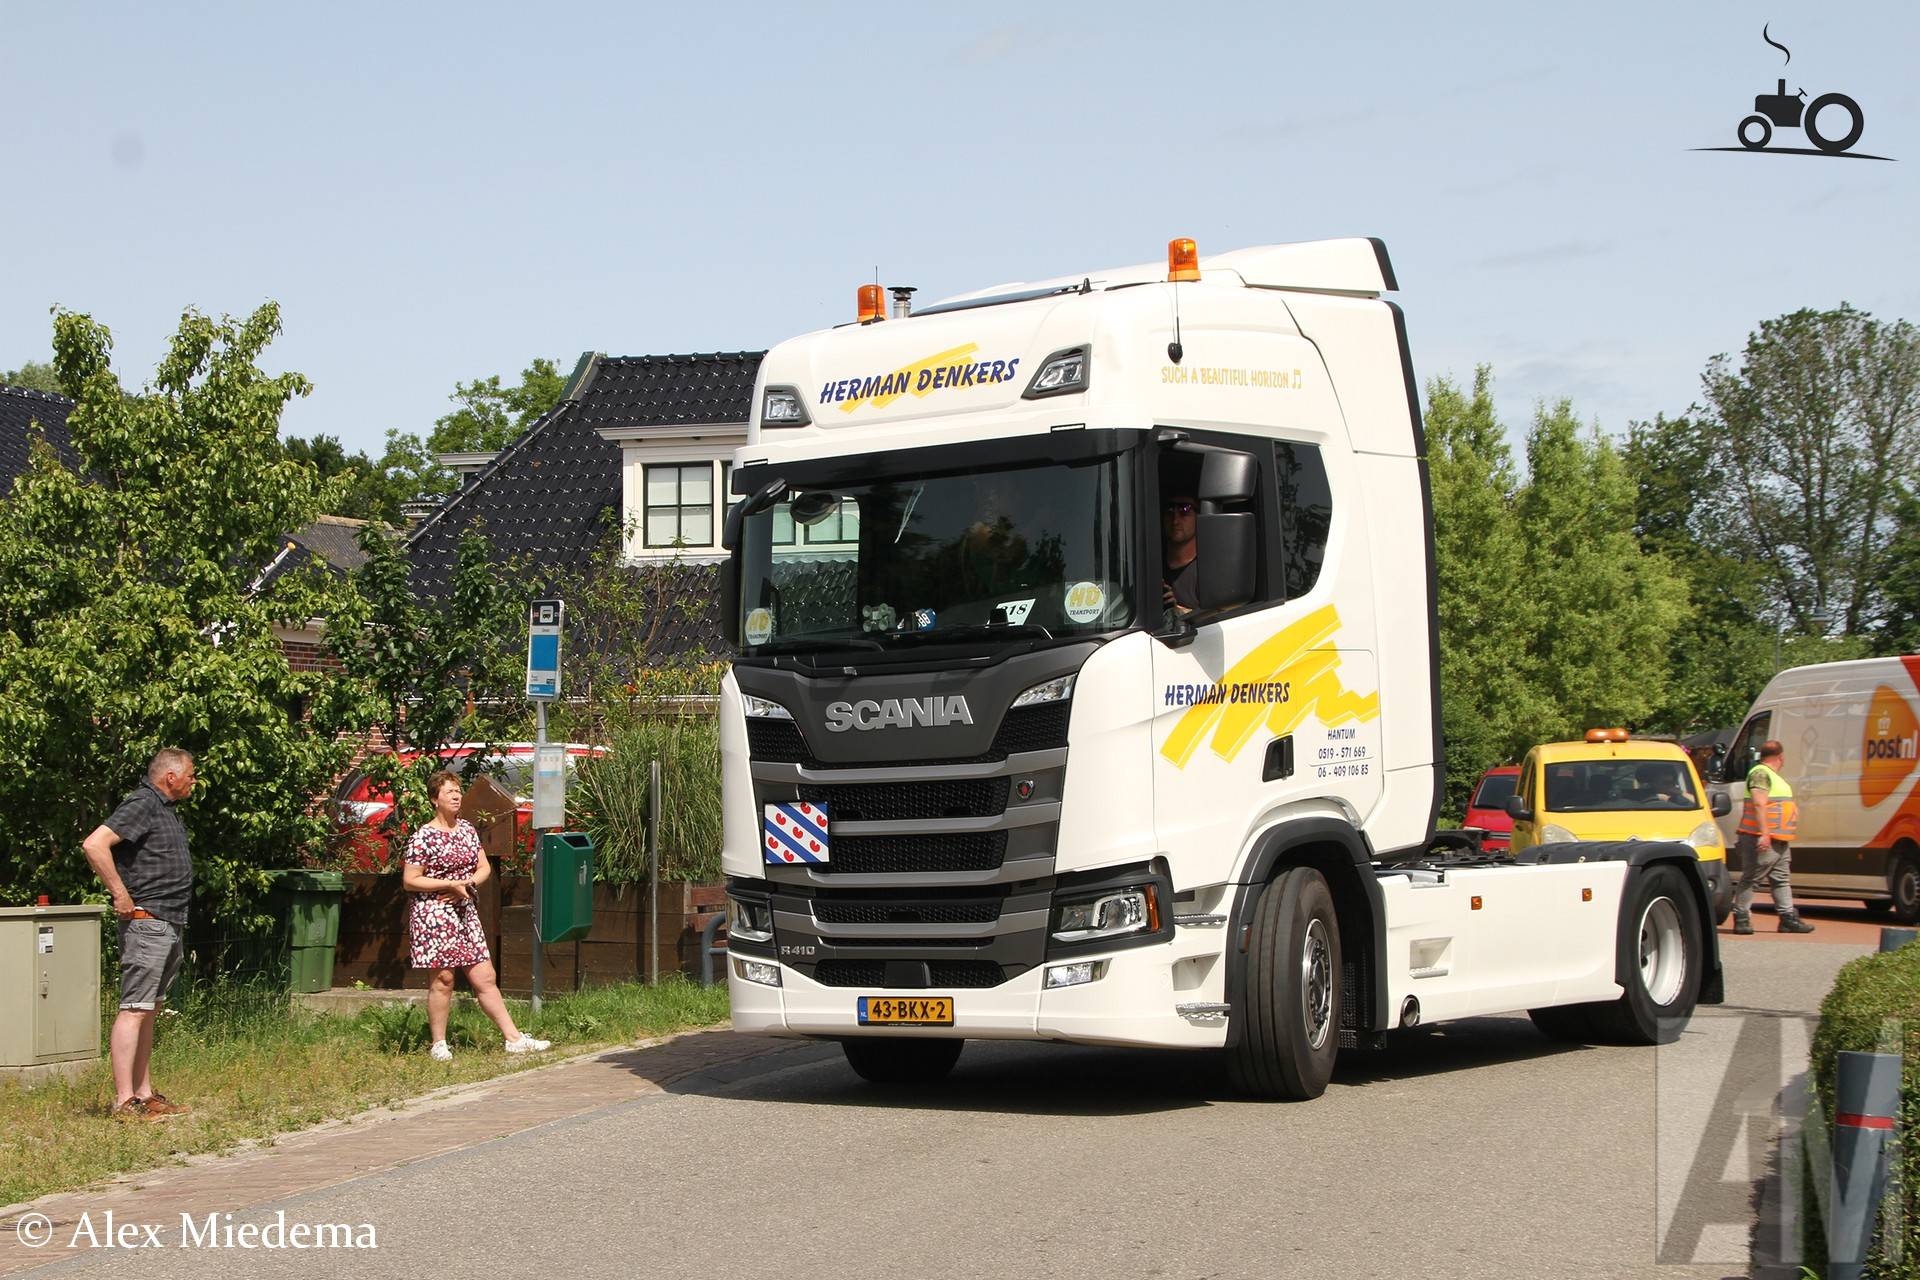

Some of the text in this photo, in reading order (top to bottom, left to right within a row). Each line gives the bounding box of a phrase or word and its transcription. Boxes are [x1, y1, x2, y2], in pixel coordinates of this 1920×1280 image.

[820, 358, 1020, 404] HERMAN DENKERS
[1161, 366, 1289, 388] SUCH A BEAUTIFUL HORIZON
[1070, 608, 1100, 616] TRANSPORT
[1165, 682, 1291, 706] HERMAN DENKERS
[825, 695, 974, 732] SCANIA
[1327, 728, 1356, 740] HANTUM
[1318, 747, 1334, 759] 0519
[1341, 746, 1352, 758] 571
[1353, 746, 1366, 758] 669
[1866, 730, 1918, 767] postnl
[1317, 766, 1327, 778] 06
[1333, 765, 1346, 777] 409
[1348, 764, 1359, 776] 106
[1361, 763, 1369, 775] 85
[872, 1000, 946, 1019] 43-BKX-2
